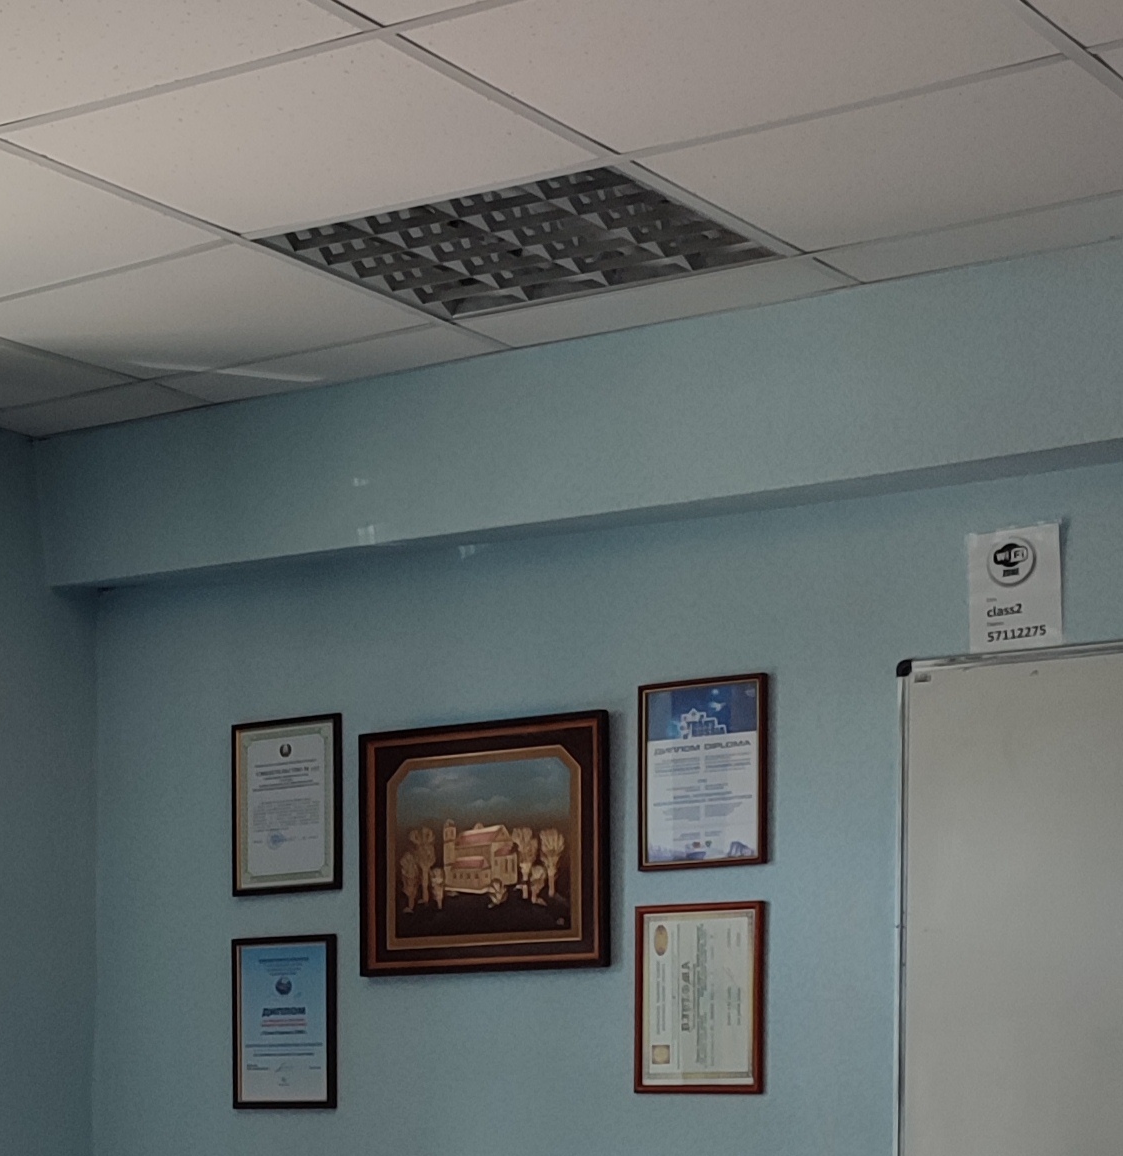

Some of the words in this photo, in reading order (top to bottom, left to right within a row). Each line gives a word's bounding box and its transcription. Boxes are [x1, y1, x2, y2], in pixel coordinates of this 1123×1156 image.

[987, 603, 1022, 617] class2
[987, 625, 1047, 642] 57112275
[704, 740, 751, 751] DIPLOMA
